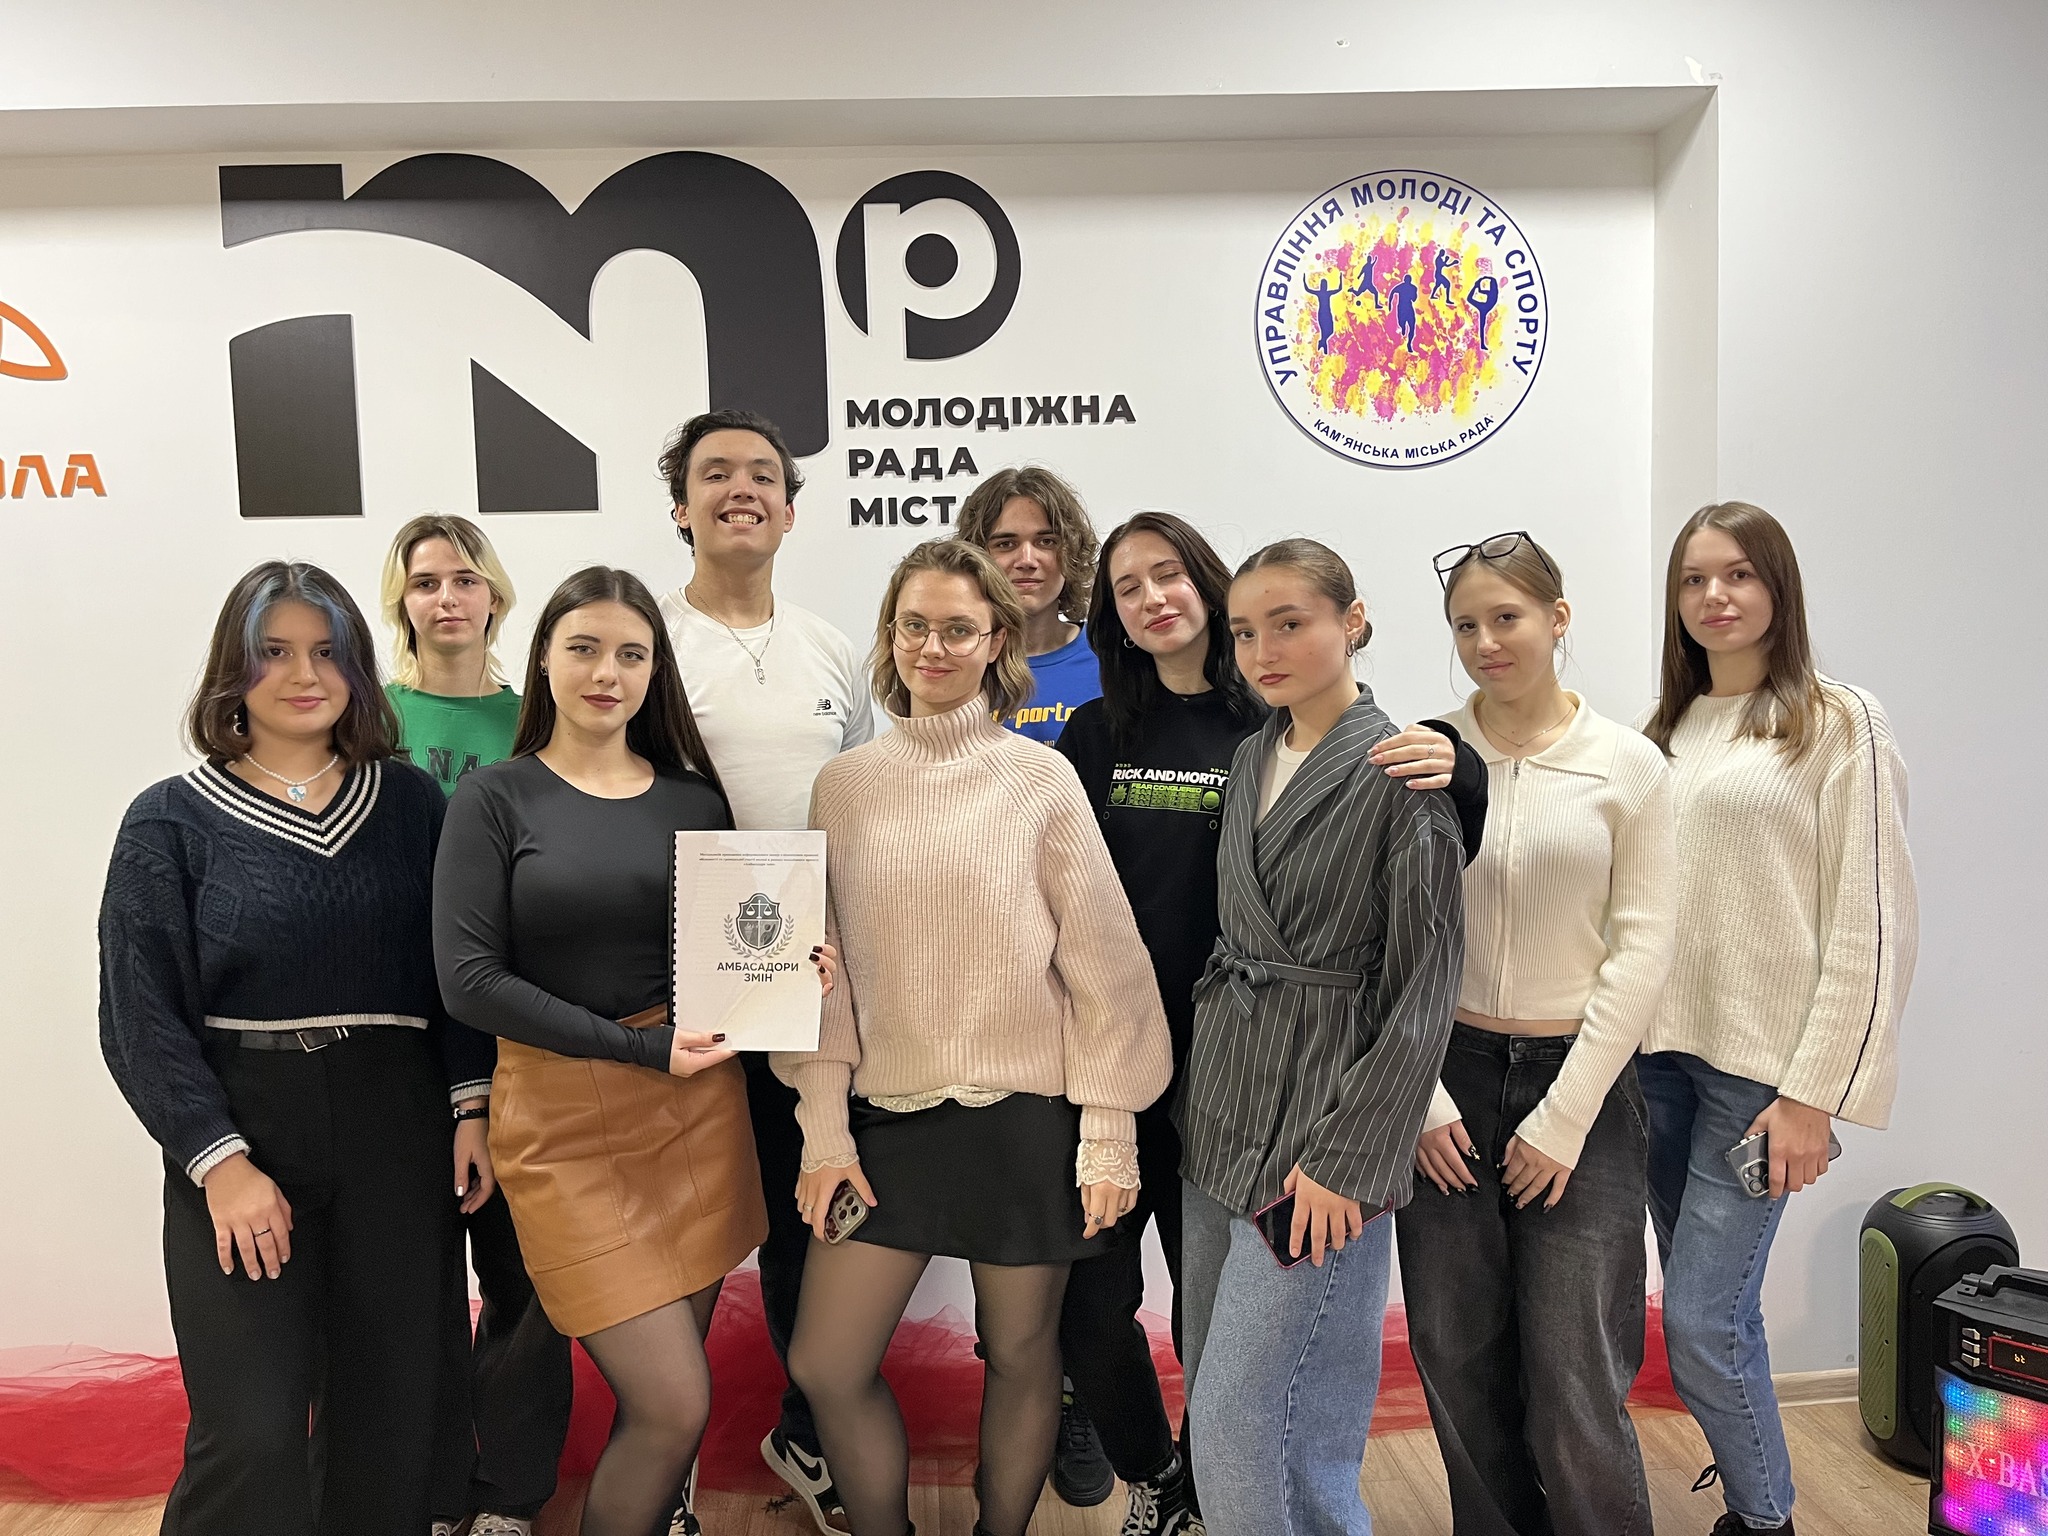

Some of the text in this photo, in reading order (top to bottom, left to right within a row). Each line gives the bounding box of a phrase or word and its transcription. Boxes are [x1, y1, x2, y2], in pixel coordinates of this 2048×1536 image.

[1265, 178, 1540, 386] УПРАВЛІННЯ МОЛОДІ ТА СПОРТУ
[846, 394, 1137, 431] МОЛОДІЖНА
[1405, 438, 1458, 459] МІСЬКА
[1459, 415, 1495, 445] РАДА
[0, 453, 108, 499] ЛА
[848, 447, 980, 481] РАДА
[849, 495, 960, 527] МІСТ
[1112, 768, 1228, 787] RICK AND MORTY
[1153, 784, 1202, 793] CONQUERED
[717, 962, 799, 972] АМБАСАДОРИ
[744, 973, 773, 982] ЗМІН
